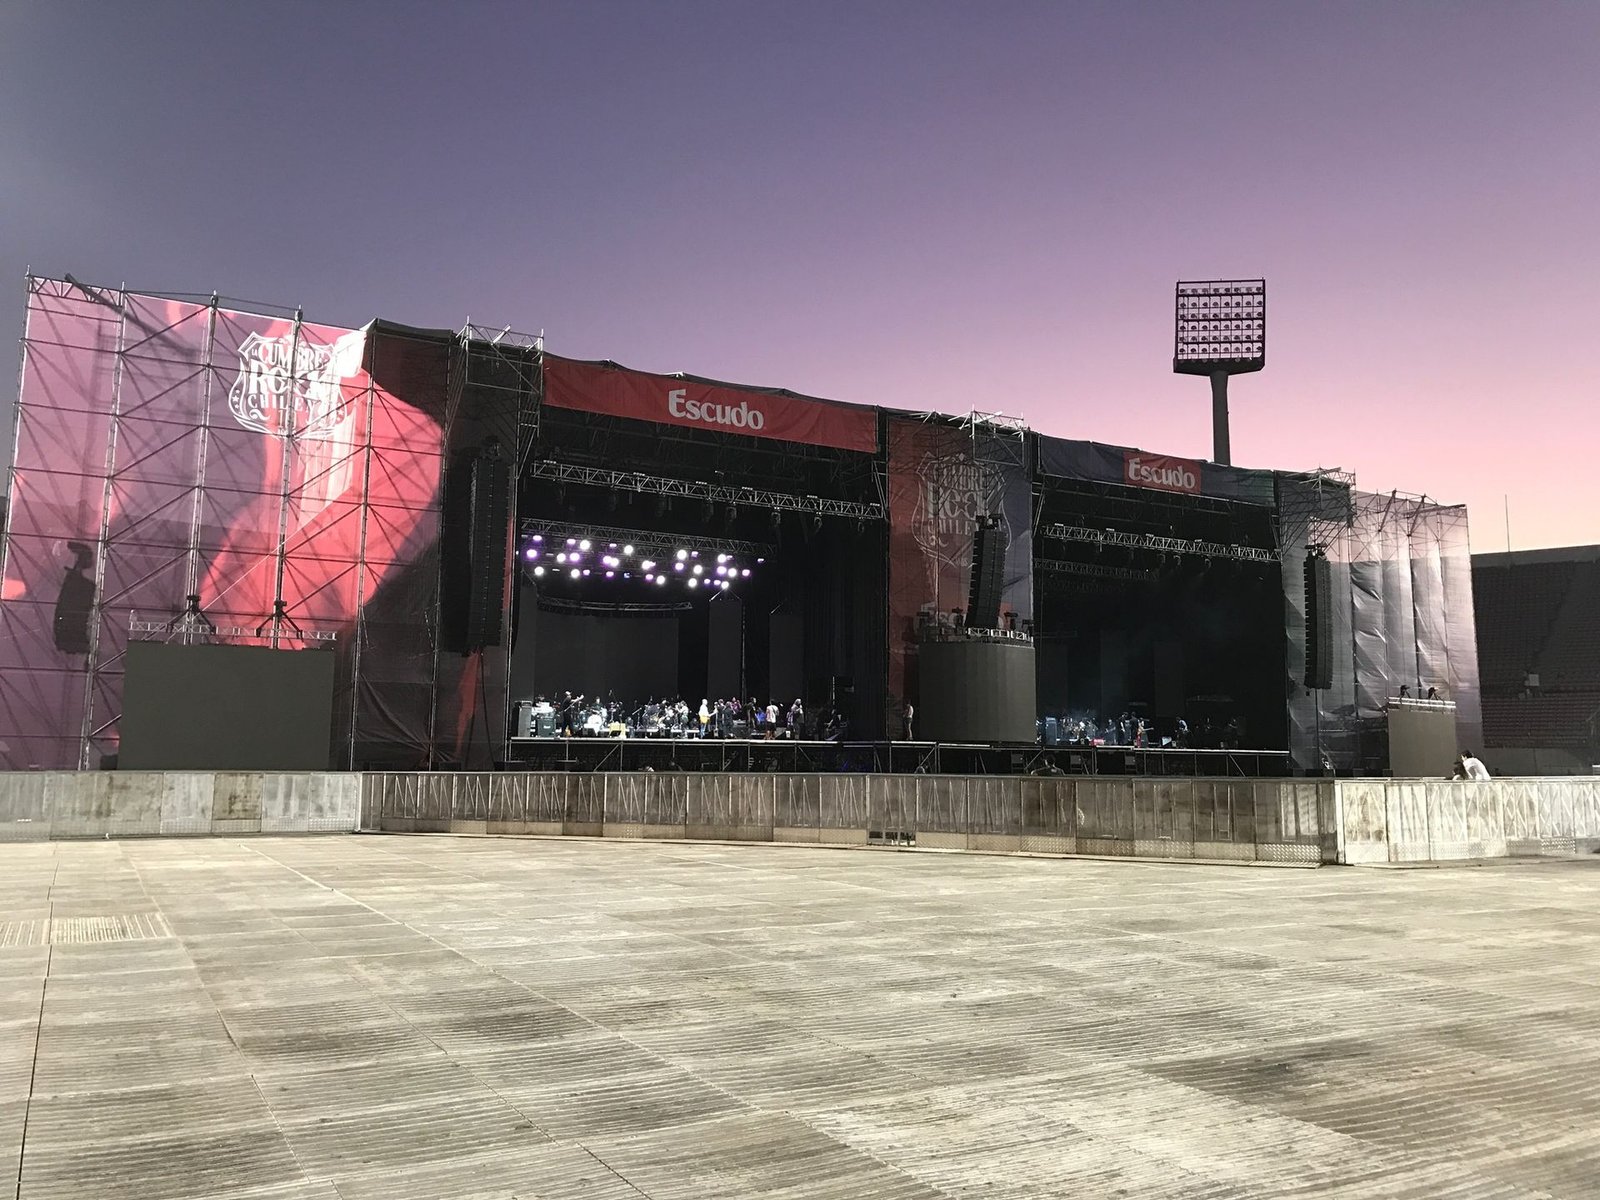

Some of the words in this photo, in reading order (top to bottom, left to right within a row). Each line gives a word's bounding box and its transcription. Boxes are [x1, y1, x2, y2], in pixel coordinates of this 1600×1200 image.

[257, 342, 326, 371] CUMBRE
[668, 389, 764, 430] Escudo
[1128, 458, 1195, 489] Escudo
